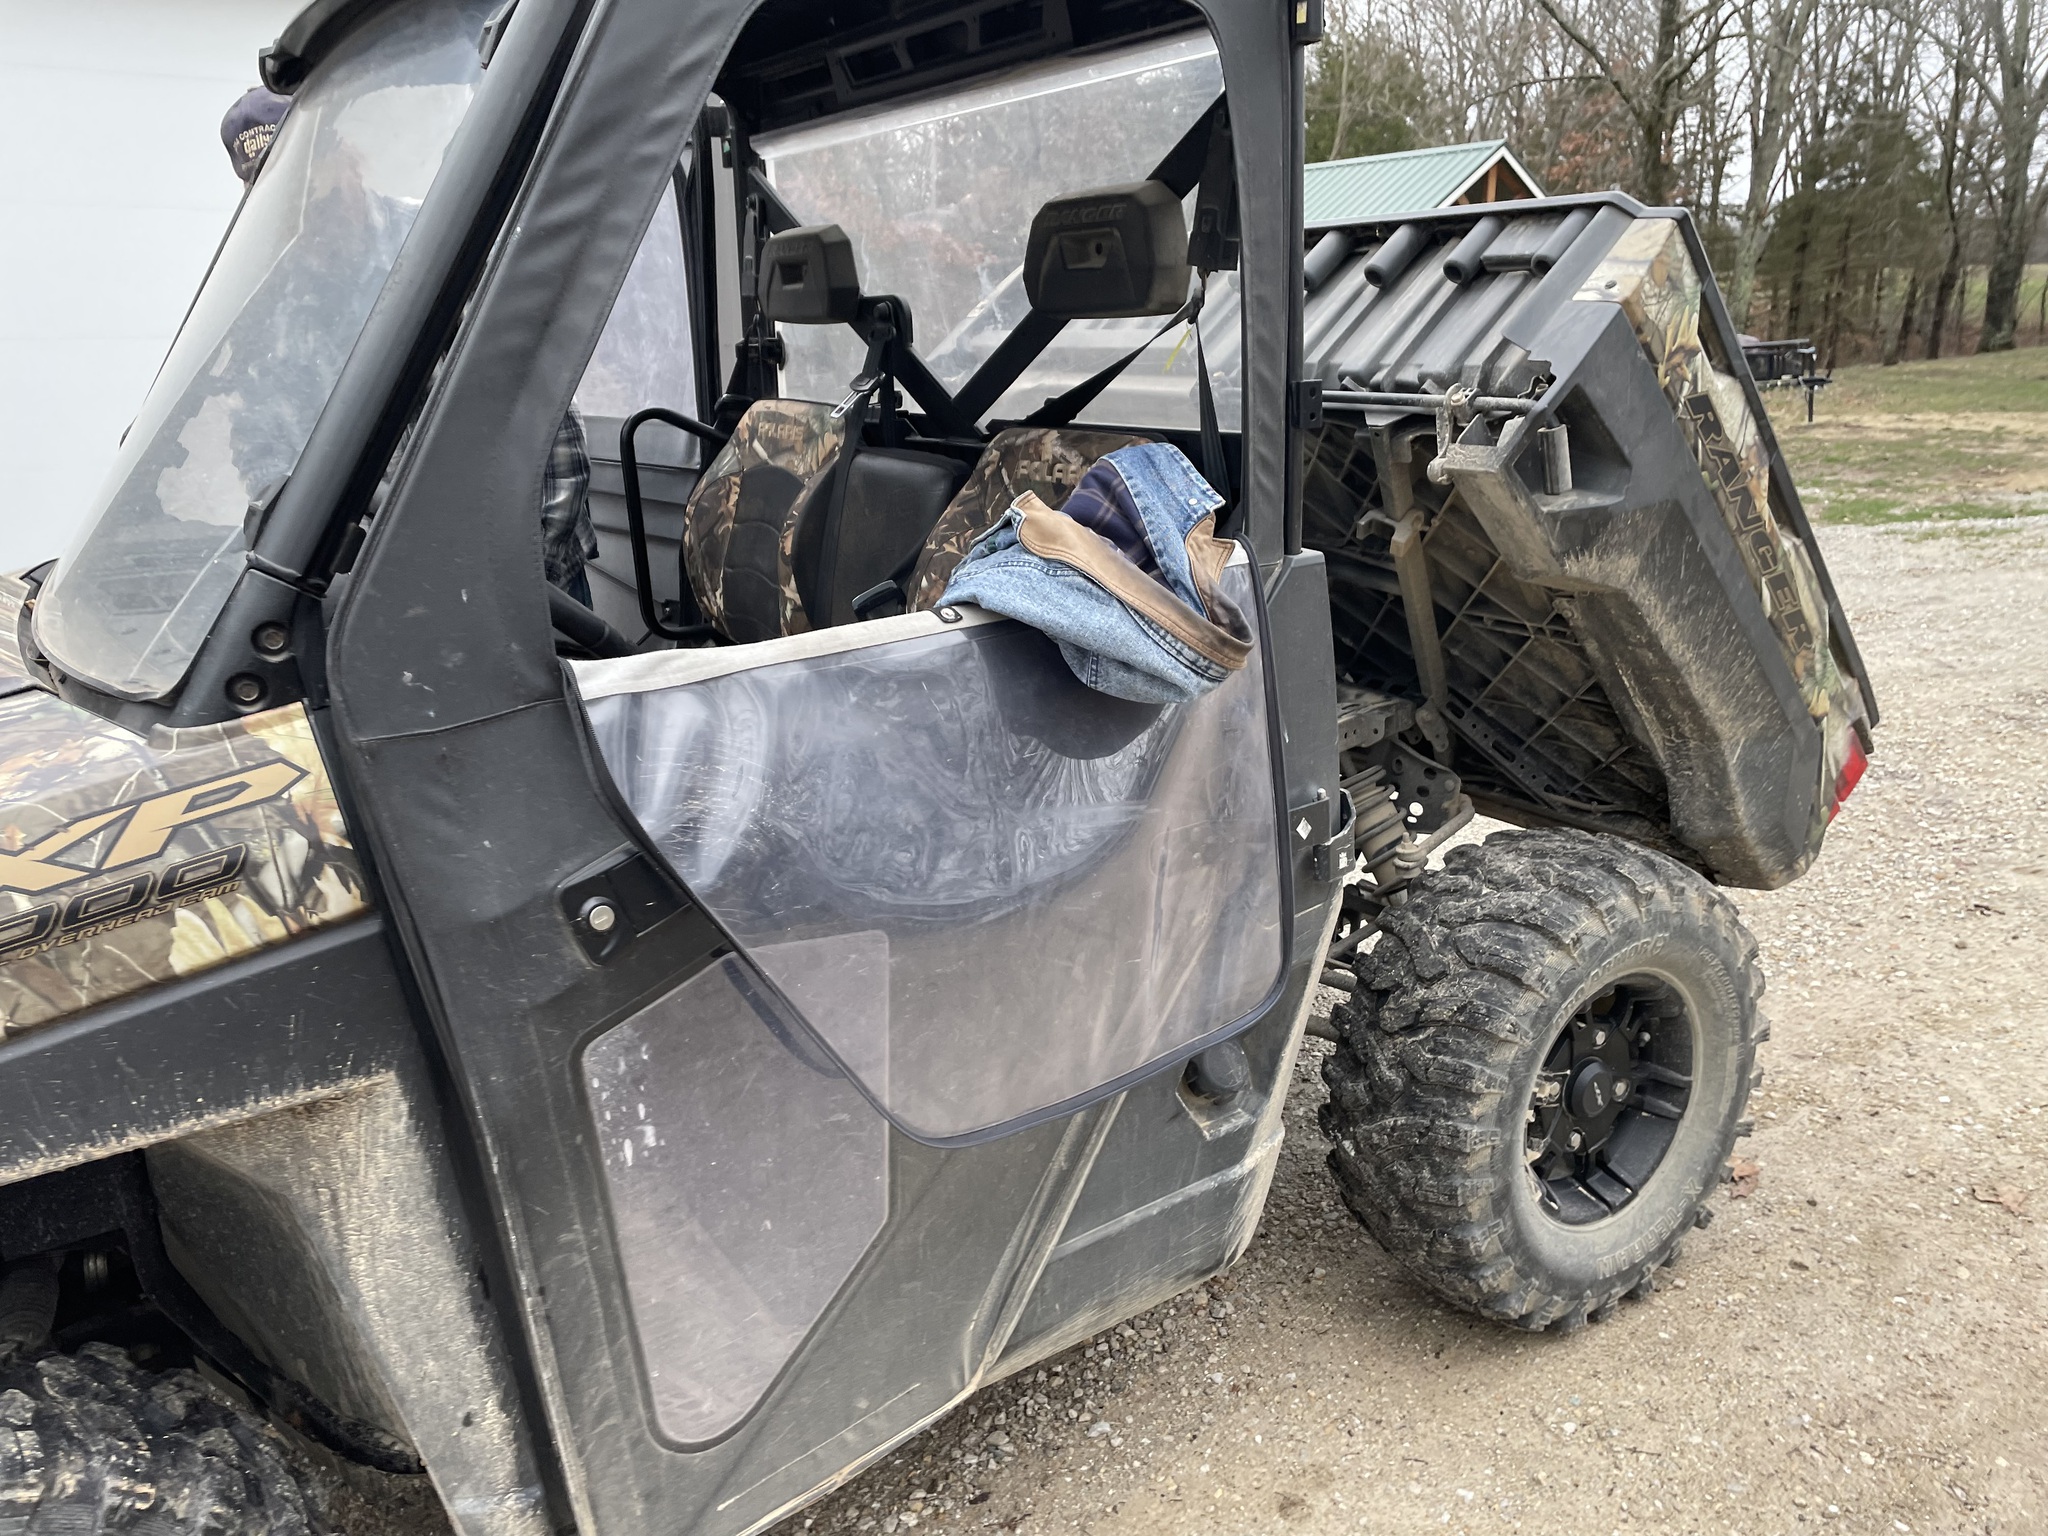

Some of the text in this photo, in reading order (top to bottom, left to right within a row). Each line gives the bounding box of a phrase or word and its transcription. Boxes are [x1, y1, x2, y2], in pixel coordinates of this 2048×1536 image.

[1685, 391, 1816, 656] RANGER
[18, 881, 241, 960] OVERHEAD CAM
[1596, 1177, 1703, 1280] X-TERRAIN
